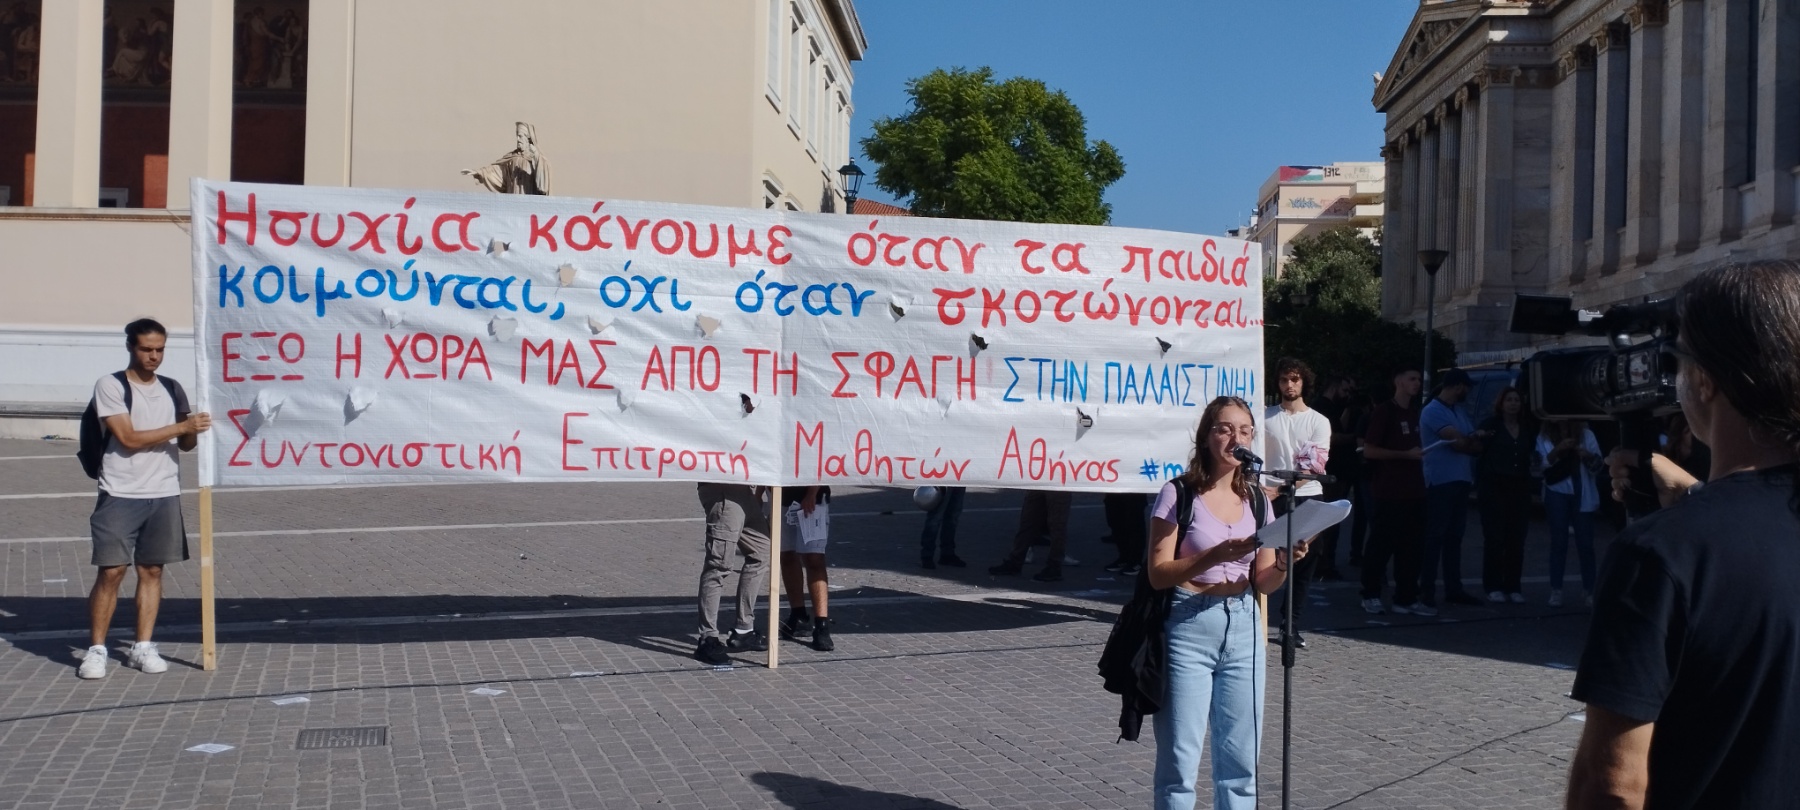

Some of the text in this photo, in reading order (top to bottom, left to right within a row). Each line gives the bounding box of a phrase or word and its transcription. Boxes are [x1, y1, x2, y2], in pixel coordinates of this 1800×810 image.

[216, 190, 1250, 288] Ησυχία κάνουμε όταν τα παιδιά
[217, 258, 567, 321] κοιμούνται,
[598, 259, 693, 314] όχι
[734, 268, 876, 319] όταν
[221, 331, 1255, 408] ΕΞΩ Η ΧΩΡΑ ΜΑΣ ΑΠΟ ΤΗ ΣΦΑΓΗ ΣΤΗΝ ΠΑΛΑΙΣΤΙΝΗ!
[227, 408, 522, 475] Συντονιστική
[561, 411, 749, 480] Επιτροπή
[794, 421, 970, 483] Μαθητών
[997, 427, 1119, 485] Αθήνας
